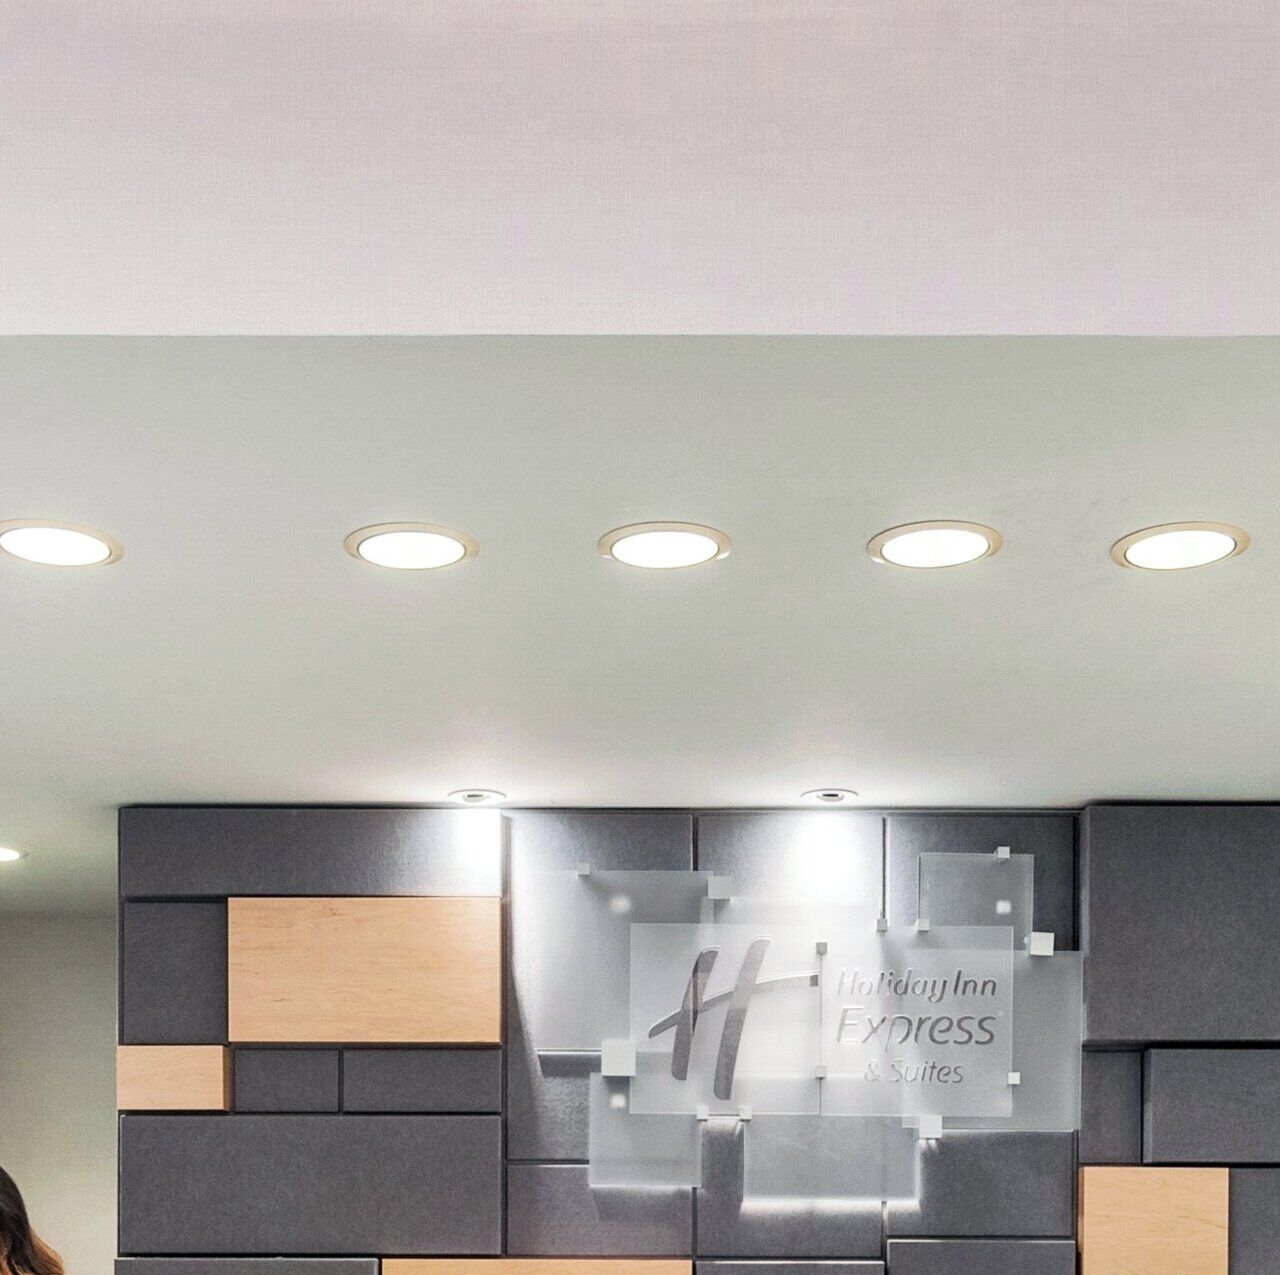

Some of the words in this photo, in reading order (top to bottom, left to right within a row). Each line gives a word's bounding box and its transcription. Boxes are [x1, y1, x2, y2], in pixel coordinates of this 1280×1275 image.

[838, 967, 947, 1003] Holiday
[953, 970, 997, 996] Inn
[837, 1005, 997, 1052] Express
[864, 1058, 881, 1083] &
[889, 1058, 964, 1083] Suites
